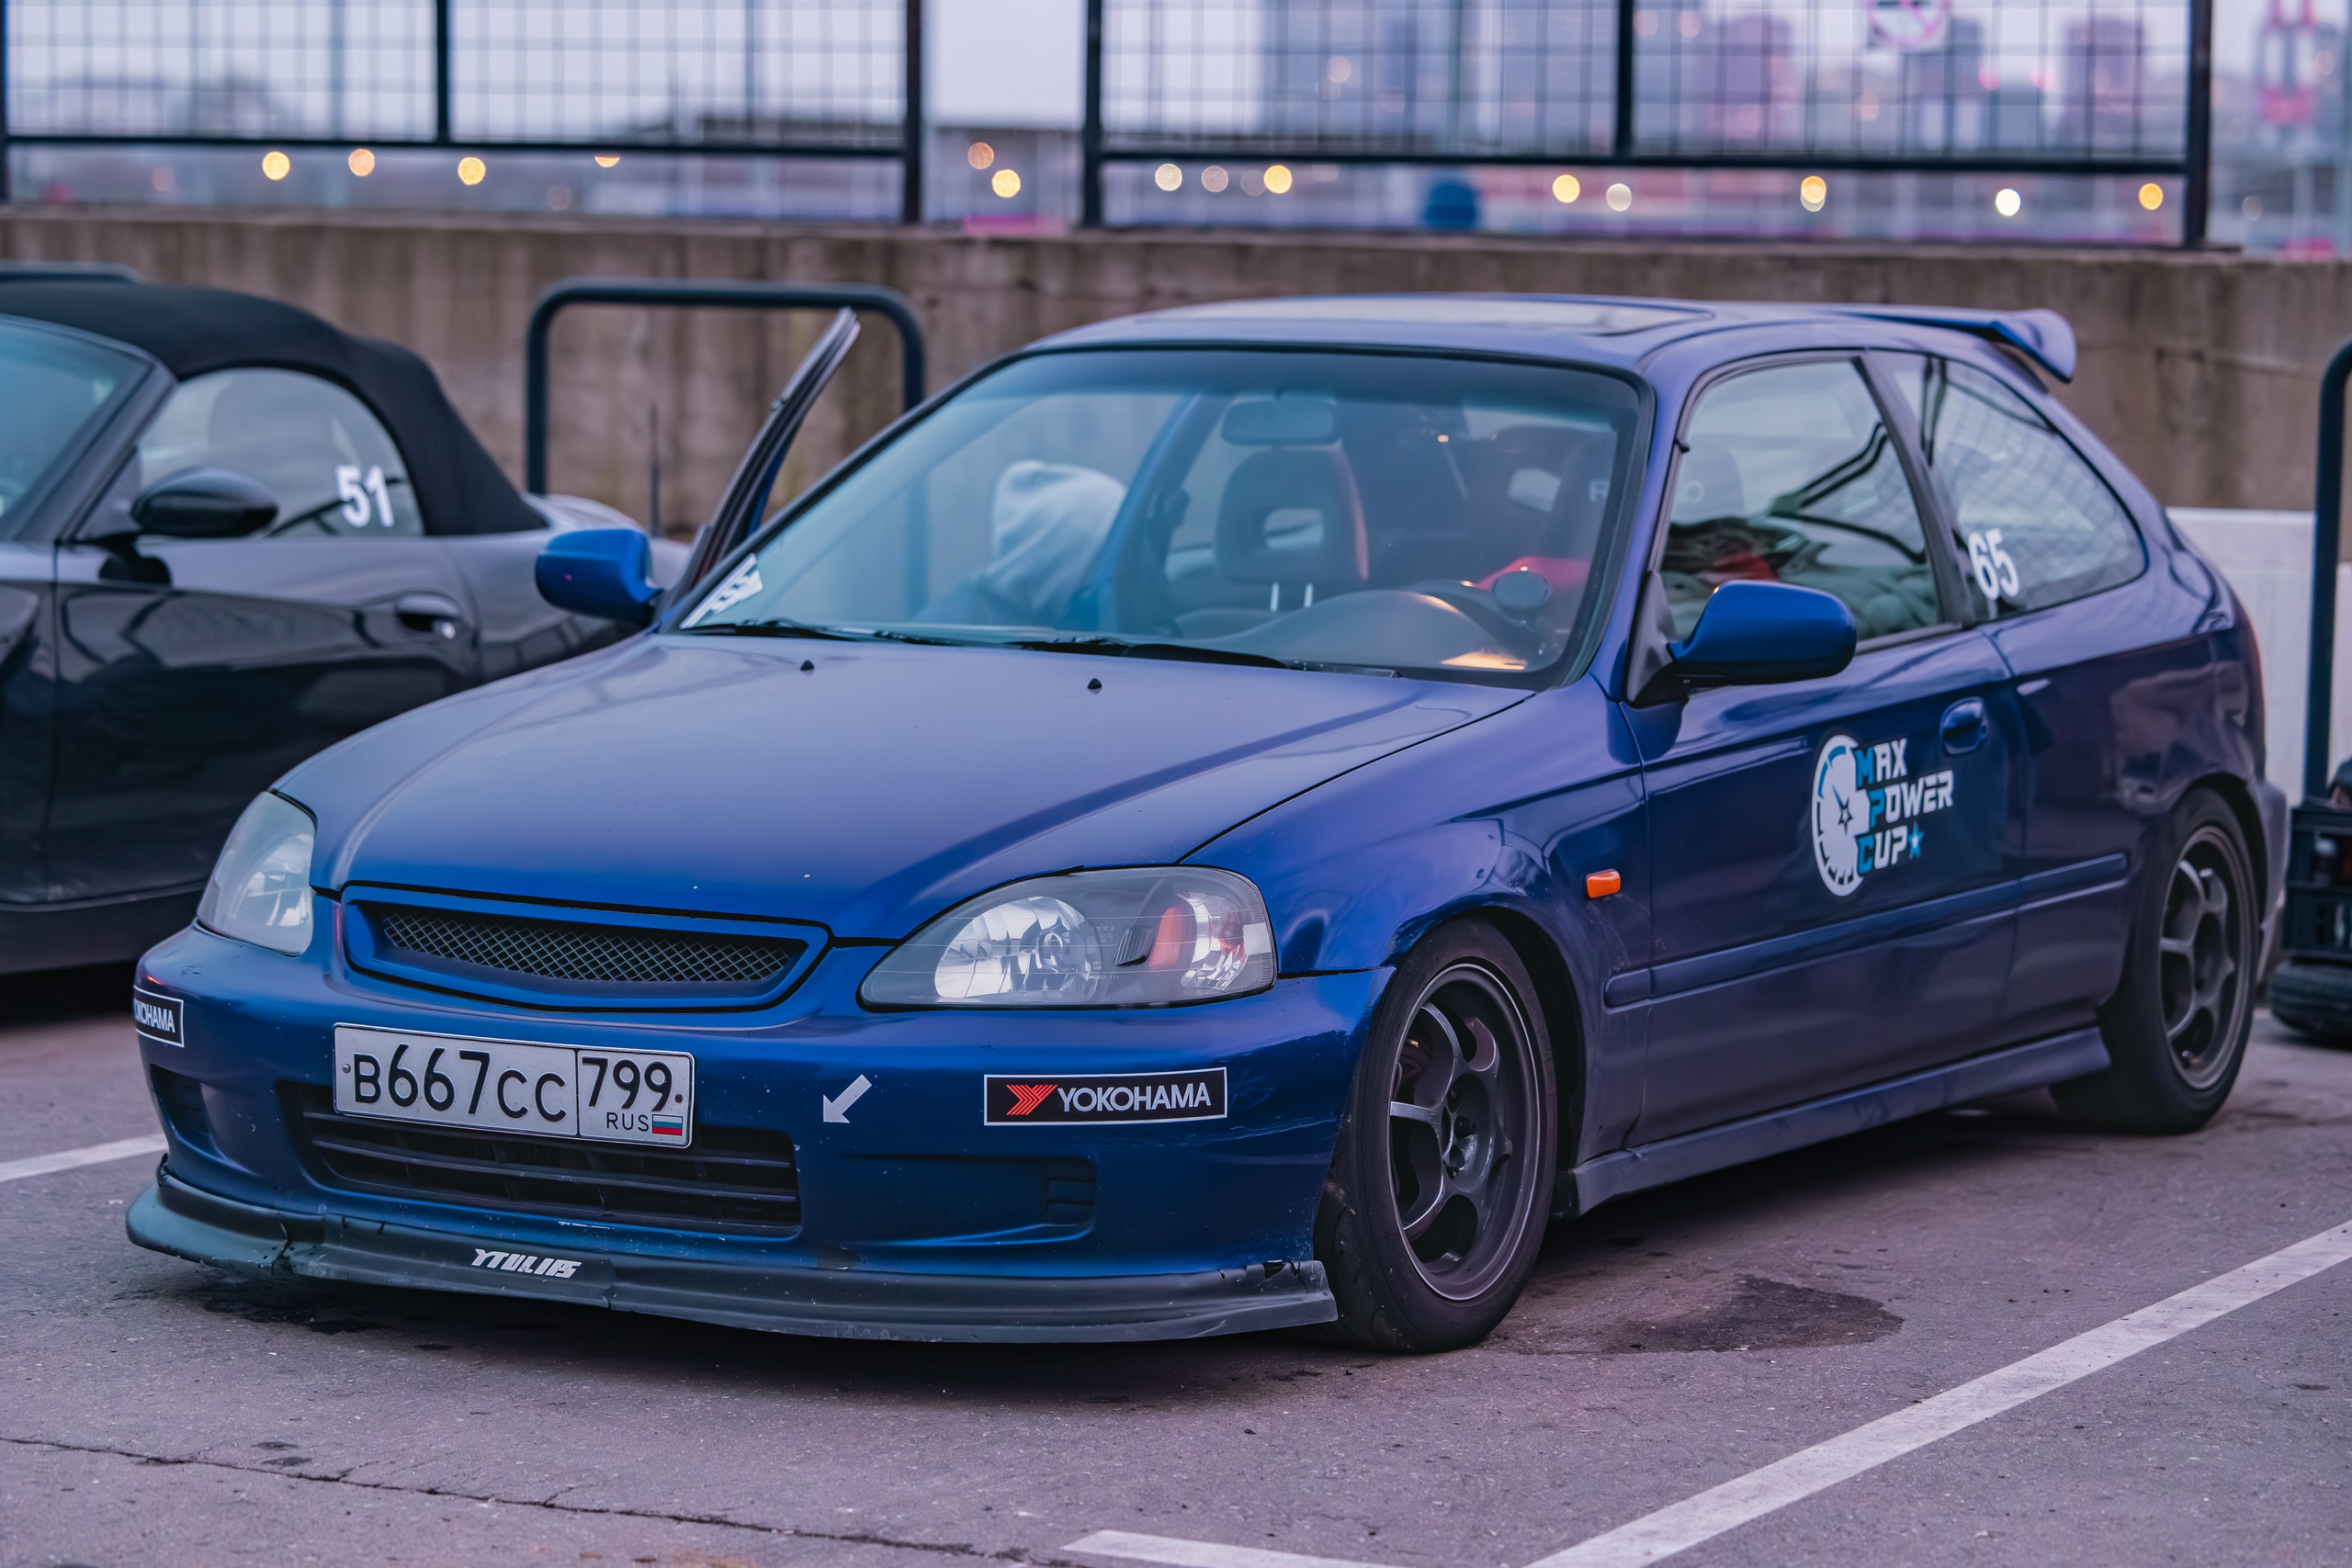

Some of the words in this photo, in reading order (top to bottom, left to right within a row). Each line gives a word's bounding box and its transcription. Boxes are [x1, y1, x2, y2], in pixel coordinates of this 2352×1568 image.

[335, 465, 395, 527] 51
[1968, 528, 2018, 600] 65
[1855, 739, 1907, 786] MAX
[1869, 770, 1953, 827] POWER
[1857, 826, 1907, 873] CUP
[582, 1056, 673, 1111] 799
[1057, 1082, 1211, 1112] YOKOHAMA
[605, 1111, 650, 1132] RUS
